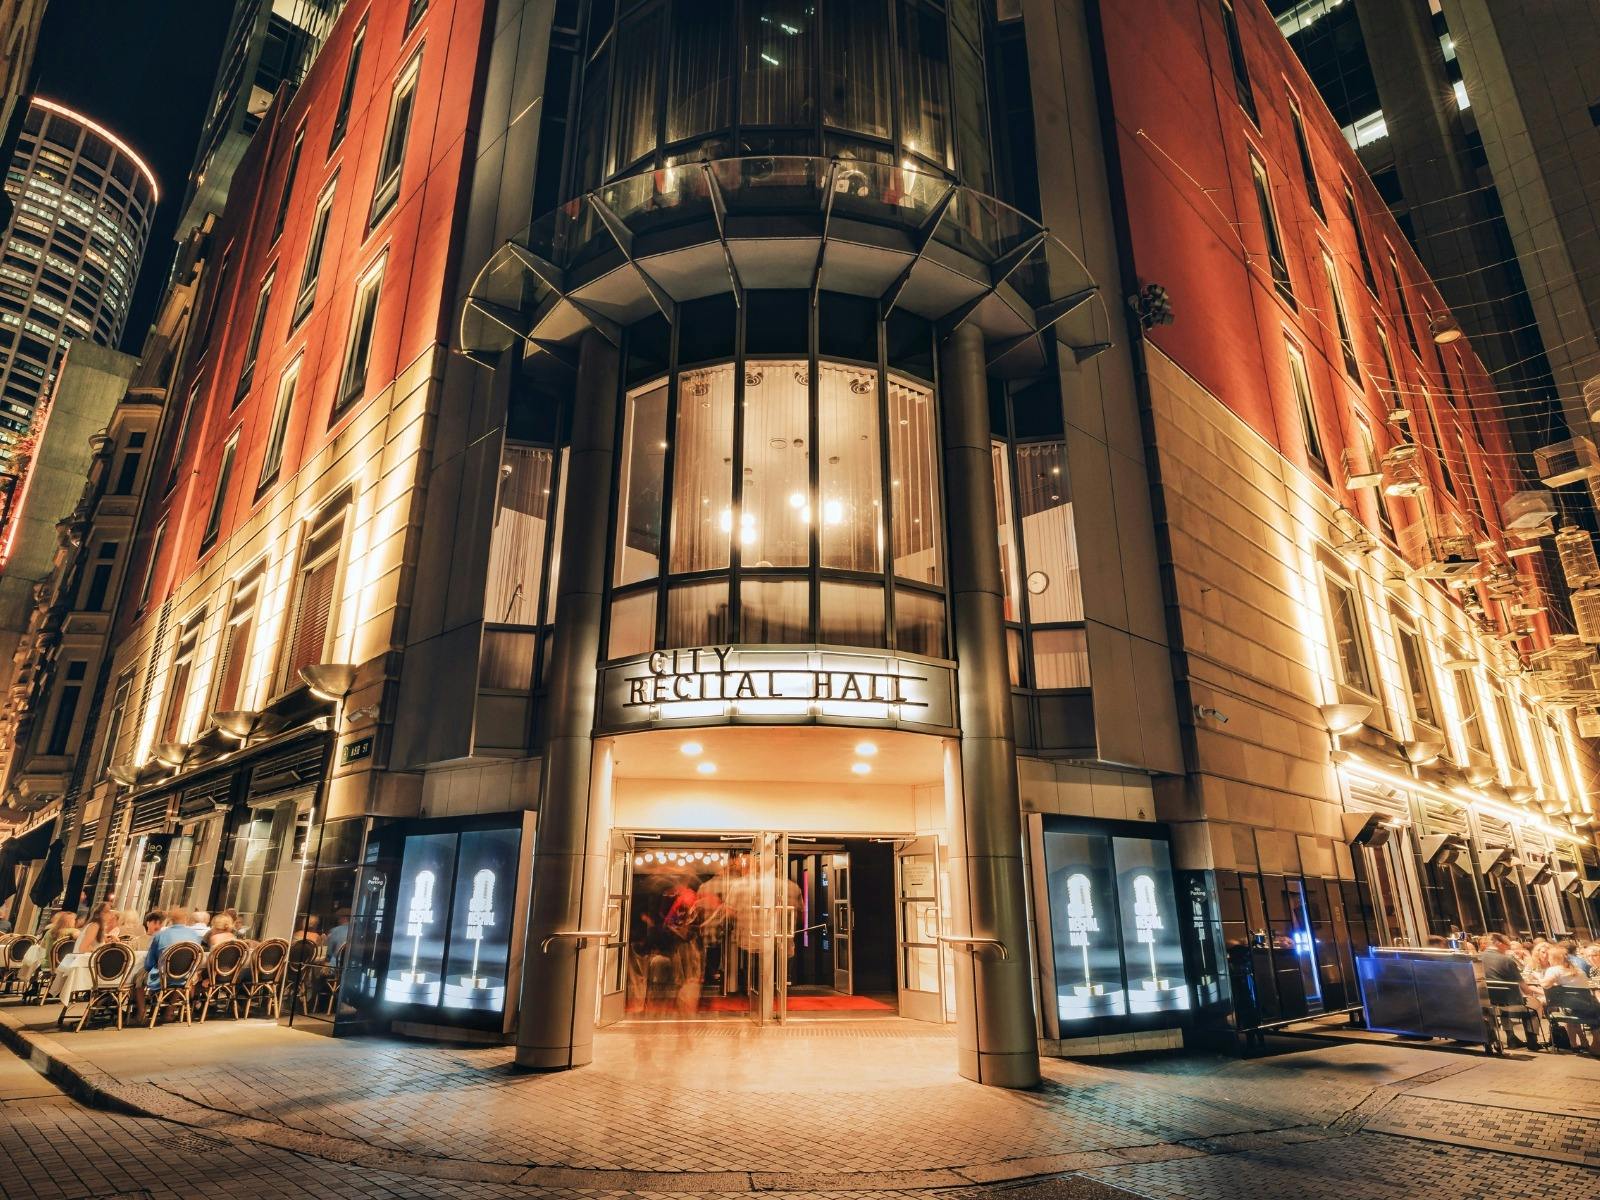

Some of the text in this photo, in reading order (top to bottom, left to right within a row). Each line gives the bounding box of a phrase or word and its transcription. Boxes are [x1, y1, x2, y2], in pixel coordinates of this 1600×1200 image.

[649, 647, 733, 675] CITY
[629, 670, 907, 704] RECITAL HALL
